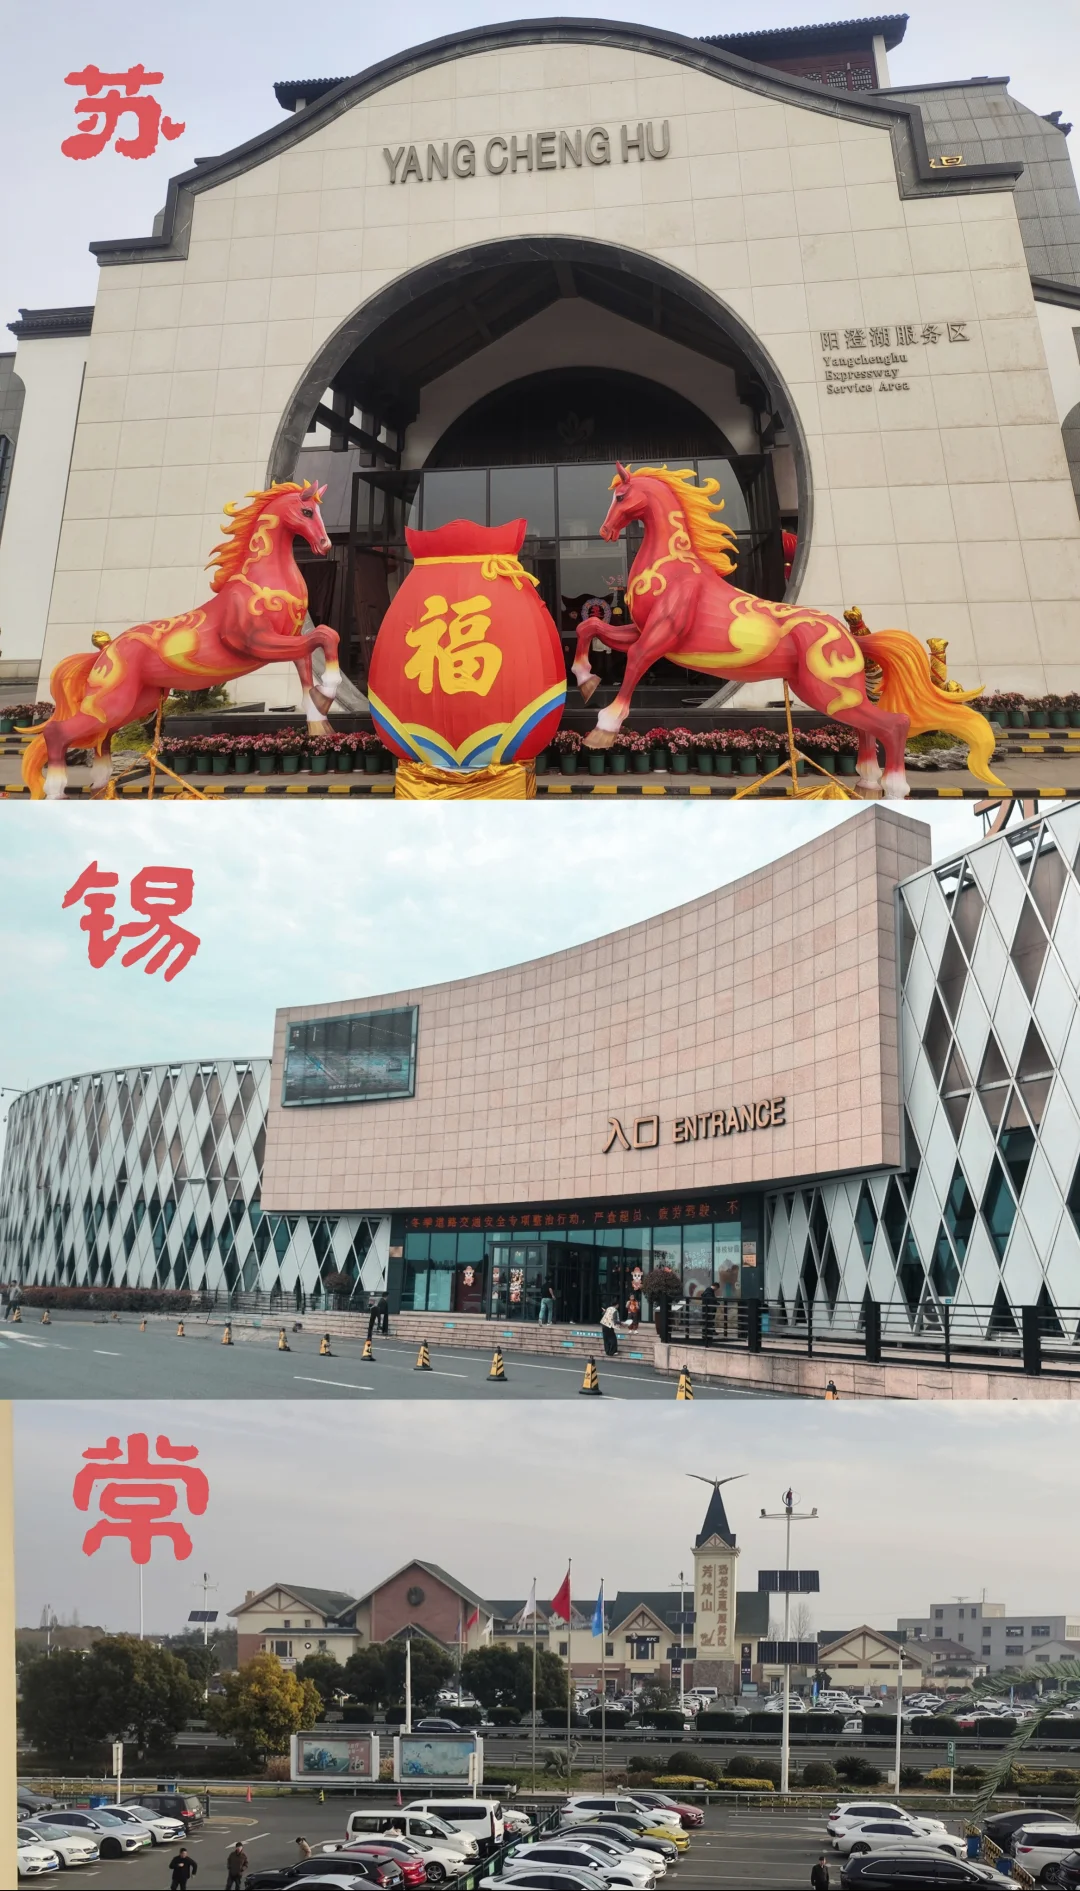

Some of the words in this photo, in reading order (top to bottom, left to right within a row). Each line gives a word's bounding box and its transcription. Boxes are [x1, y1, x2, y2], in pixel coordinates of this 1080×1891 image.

[383, 139, 476, 184] YANG
[485, 126, 611, 175] CHENG
[621, 120, 670, 163] HU
[820, 322, 970, 351] 阳澄湖服务区
[823, 353, 908, 368] Yangchenghu
[825, 368, 900, 382] Expressway
[827, 381, 873, 395] Service
[879, 381, 910, 392] Area
[404, 595, 503, 697] 福
[602, 1115, 660, 1154] 入口
[672, 1096, 786, 1144] ENTRANCE
[701, 1565, 714, 1612] 芳茂山
